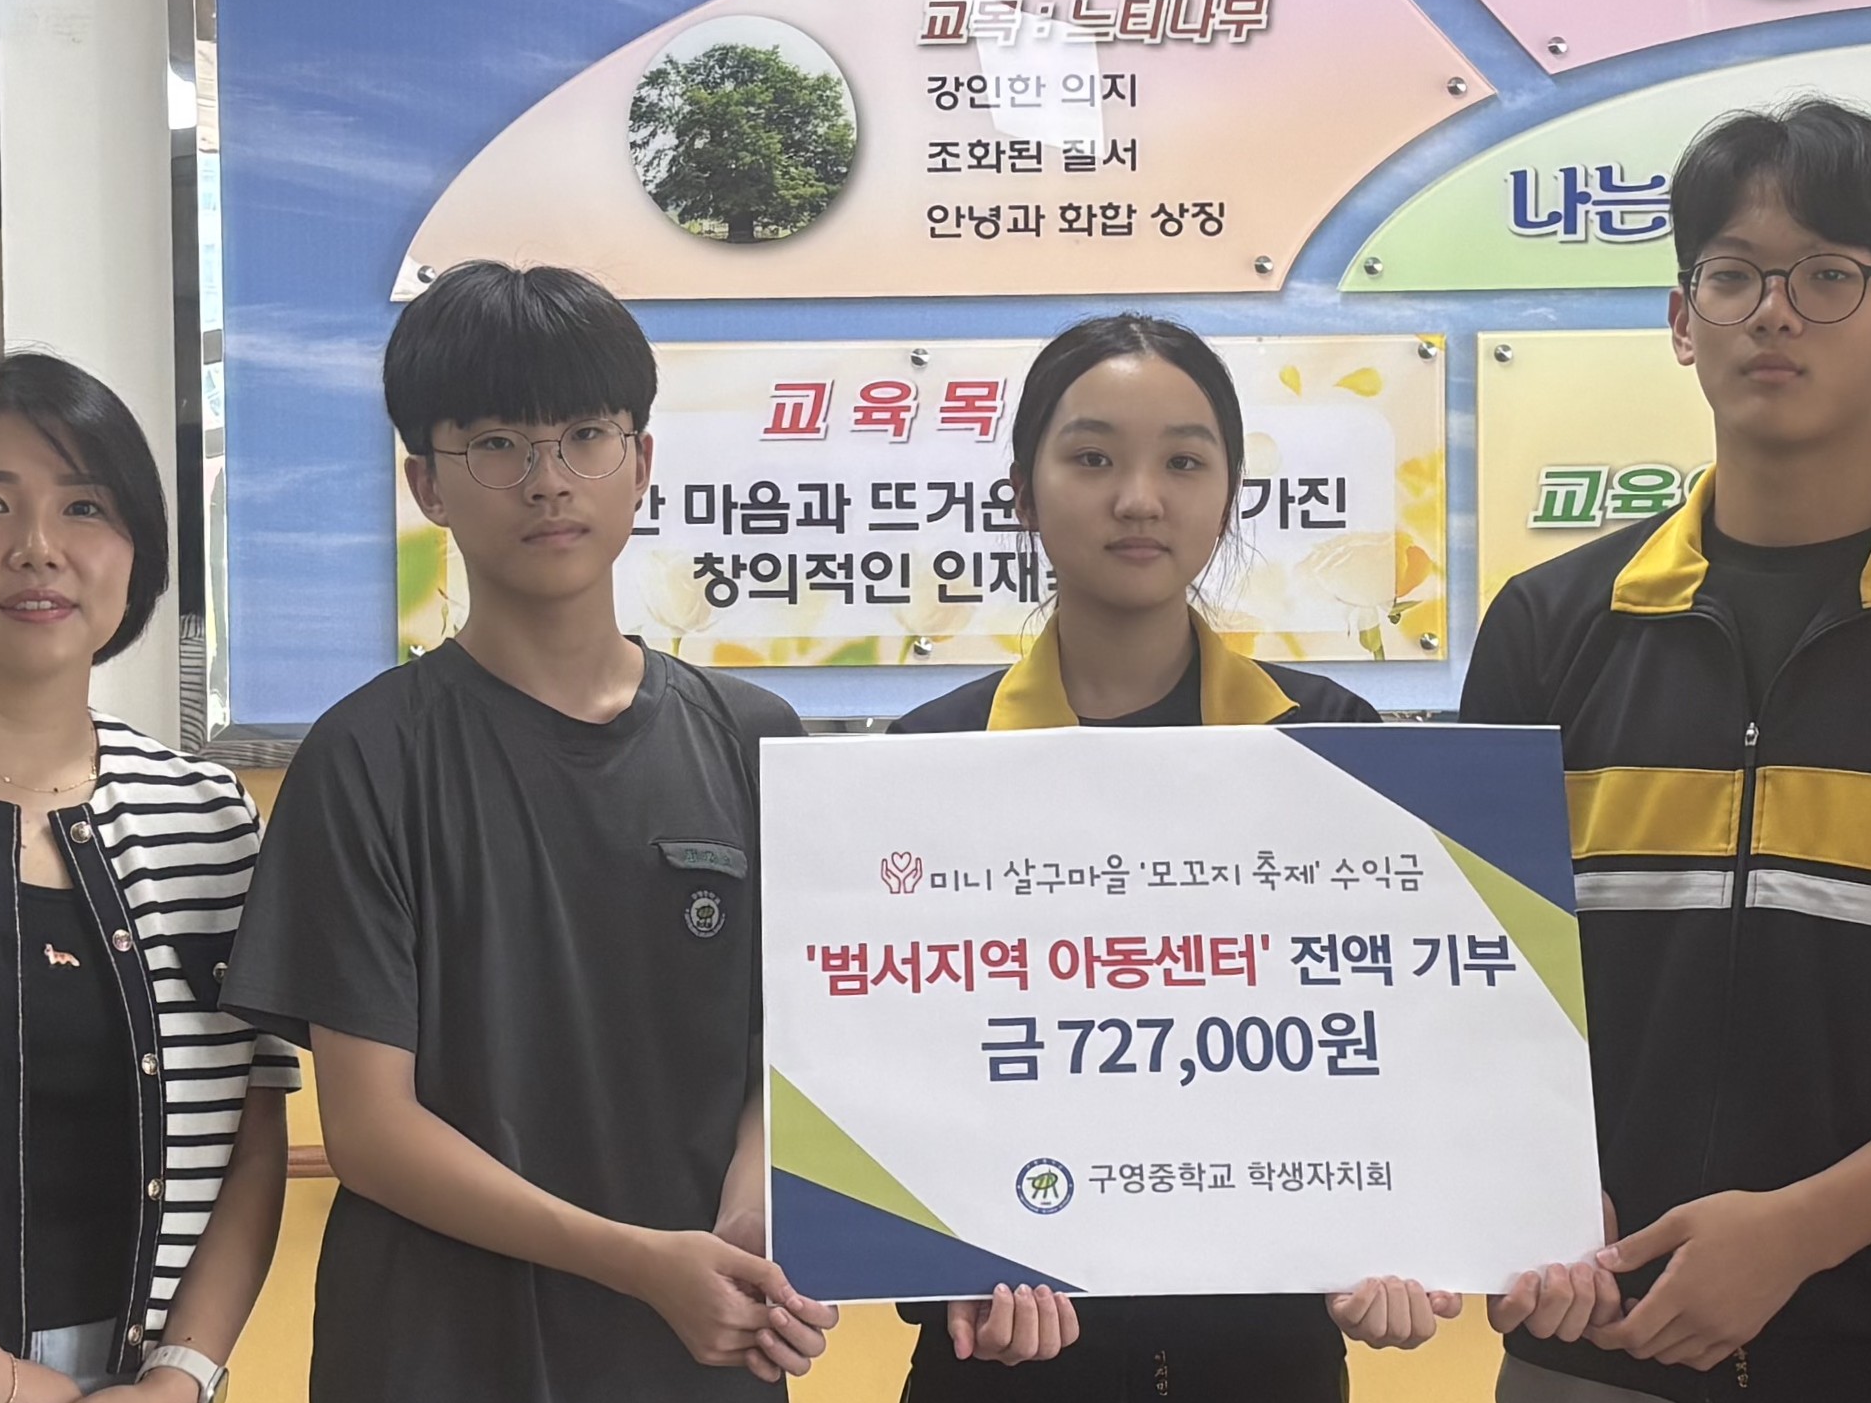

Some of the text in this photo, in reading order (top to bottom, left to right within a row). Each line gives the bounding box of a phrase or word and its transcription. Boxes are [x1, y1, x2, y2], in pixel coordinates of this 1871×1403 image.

[927, 72, 1137, 111] 강인한 의지
[926, 138, 1137, 173] 조화된 질서
[926, 201, 1225, 240] 안녕과 화합 상징
[1509, 163, 1671, 238] 나는
[684, 480, 851, 536] 마음과
[1241, 477, 1347, 530] 가진
[1531, 463, 1708, 526] 교육
[693, 549, 1060, 609] 창의적인 인재
[930, 849, 1425, 896] 미니 살구마을 '모꼬지 축제' 수익금
[804, 932, 1517, 997] '범서지역 아동센터' 전액 기부
[979, 1008, 1383, 1088] 금 727,000원
[1087, 1162, 1236, 1195] 구영중학교
[1247, 1159, 1393, 1193] 학생자치회
